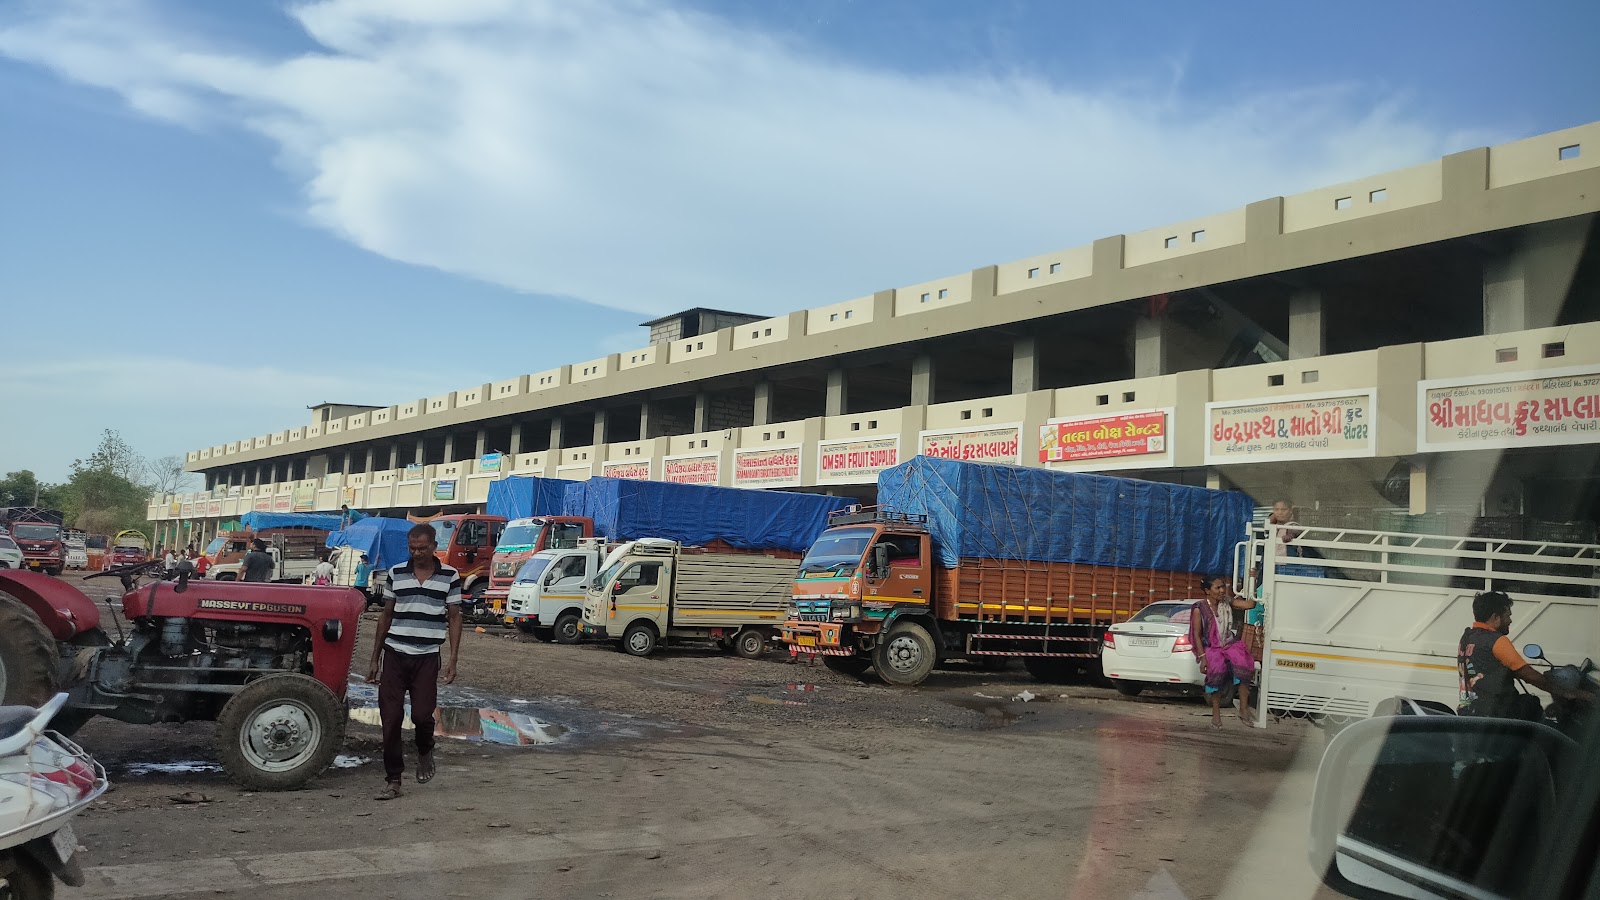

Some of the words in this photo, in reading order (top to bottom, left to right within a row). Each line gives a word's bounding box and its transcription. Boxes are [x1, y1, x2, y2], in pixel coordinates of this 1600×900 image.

[1124, 421, 1160, 437] સેન્ટર
[1277, 418, 1288, 438] &
[848, 451, 869, 469] FRUIT
[201, 599, 245, 610] MASSEY
